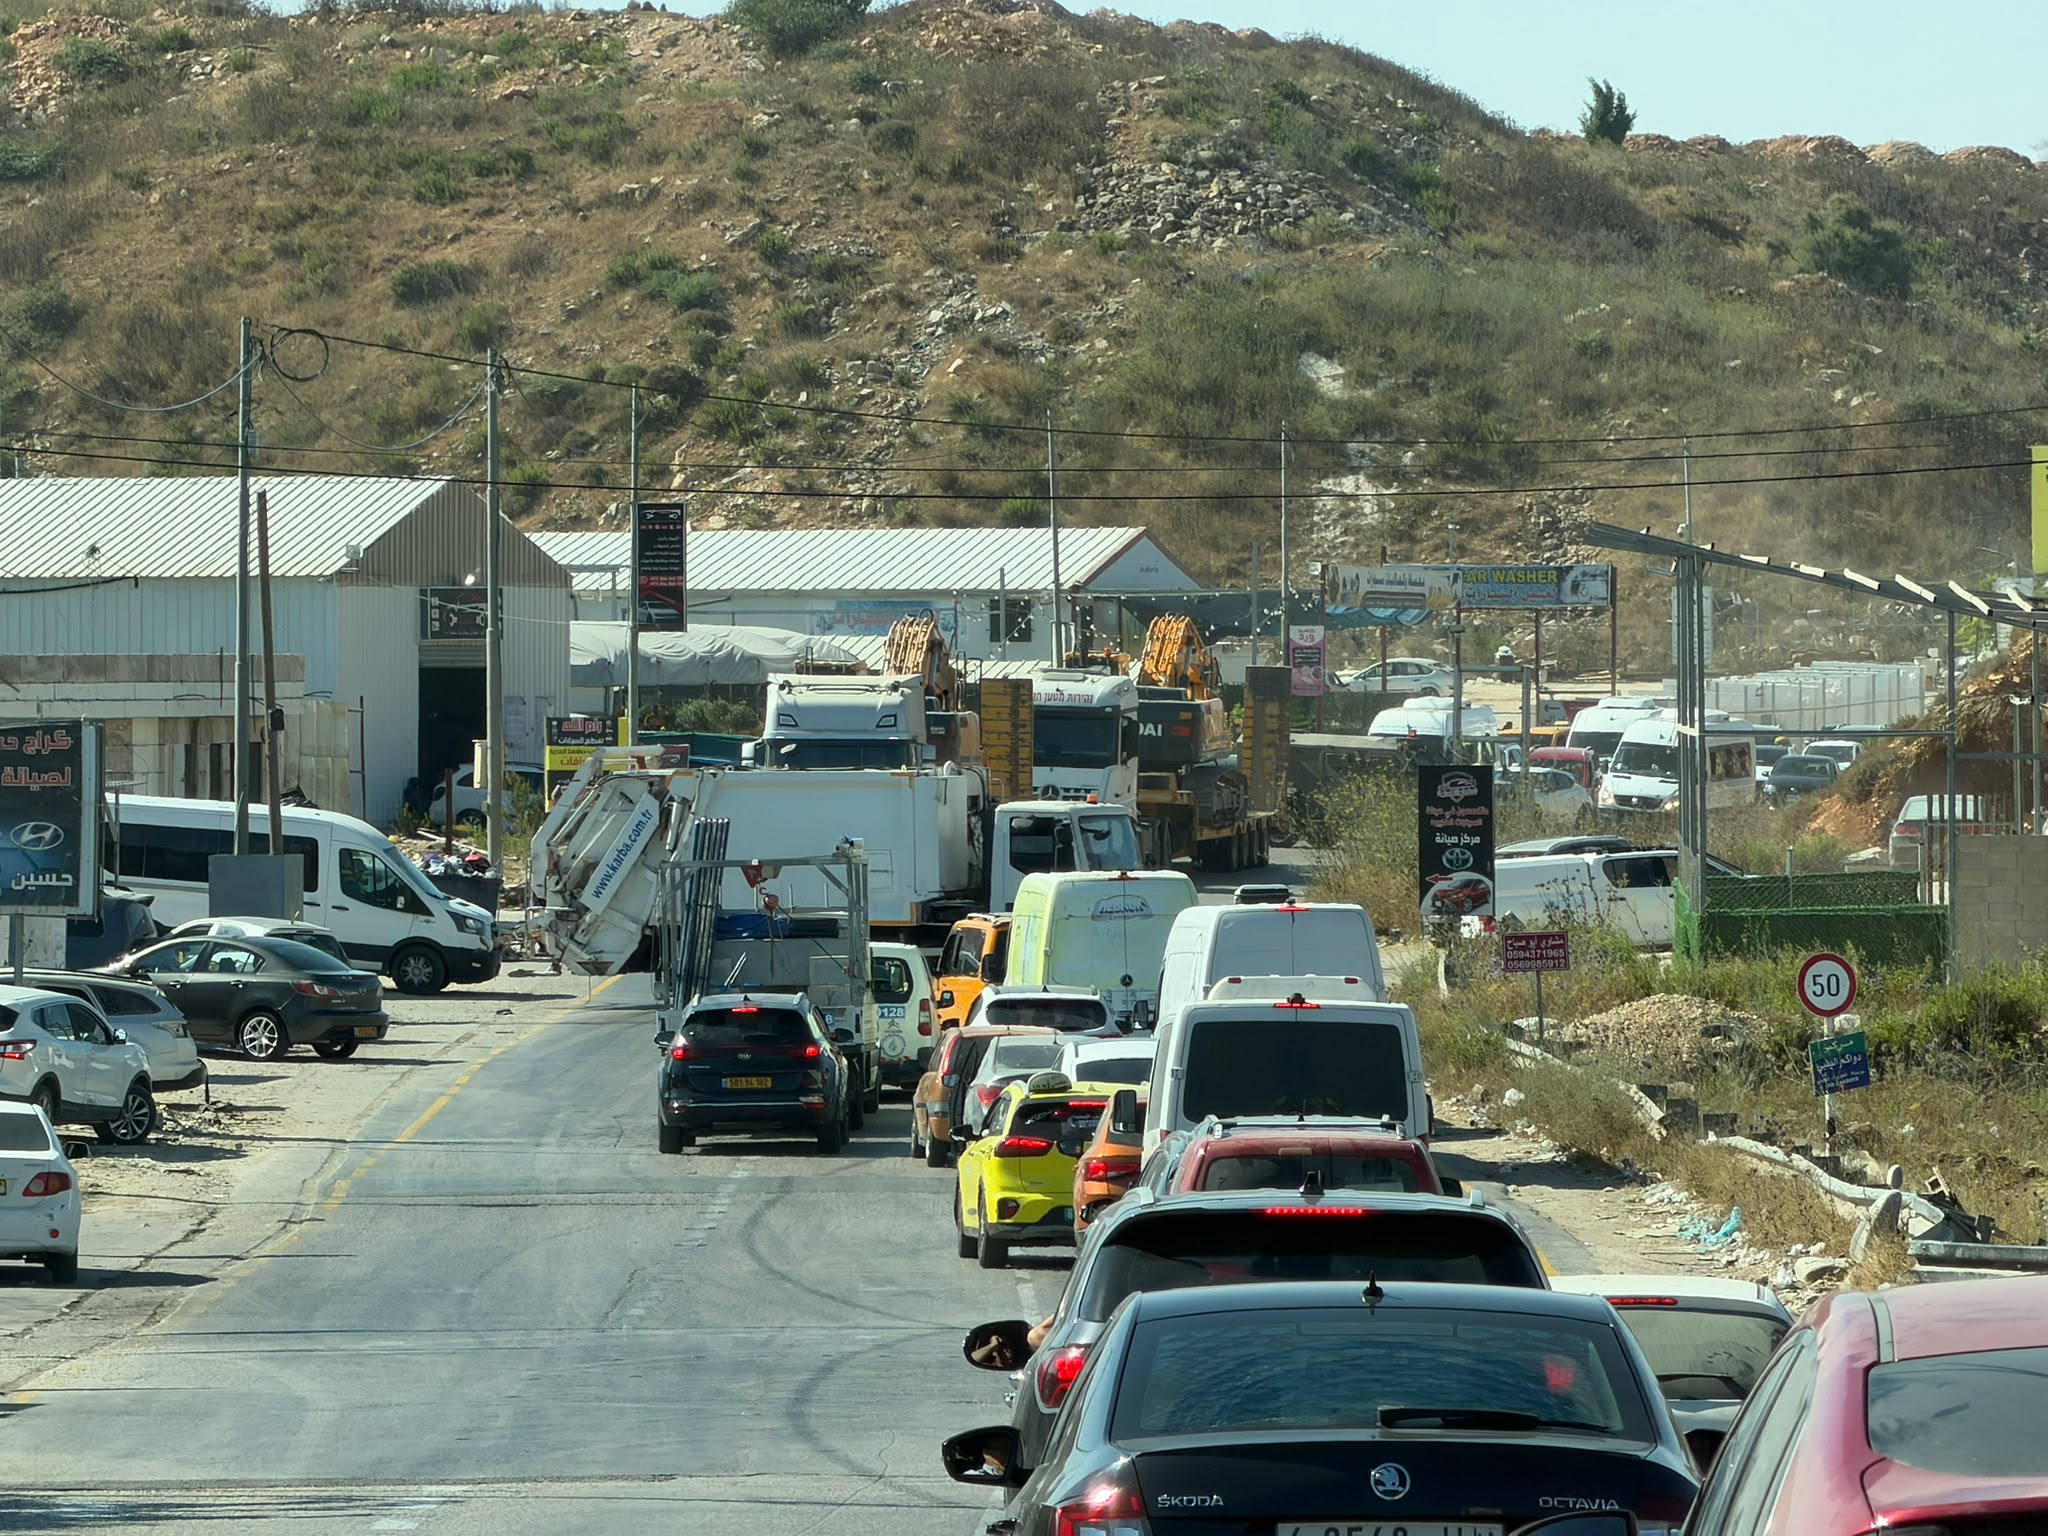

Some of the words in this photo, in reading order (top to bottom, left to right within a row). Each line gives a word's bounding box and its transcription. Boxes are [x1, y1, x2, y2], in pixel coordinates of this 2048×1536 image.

[1464, 570, 1488, 583] AR
[1492, 570, 1558, 583] WASHER
[23, 729, 72, 754] كراج
[1, 766, 72, 791] لصيانة
[1434, 832, 1459, 846] صيانة
[1460, 832, 1481, 846] مركز
[591, 808, 653, 899] www.karba.com.tr
[10, 871, 74, 890] حسين
[1506, 949, 1565, 959] 0594371965
[1812, 973, 1840, 998] 50
[1157, 1494, 1224, 1508] ŠKODA
[1539, 1496, 1620, 1510] OCTAVIA
